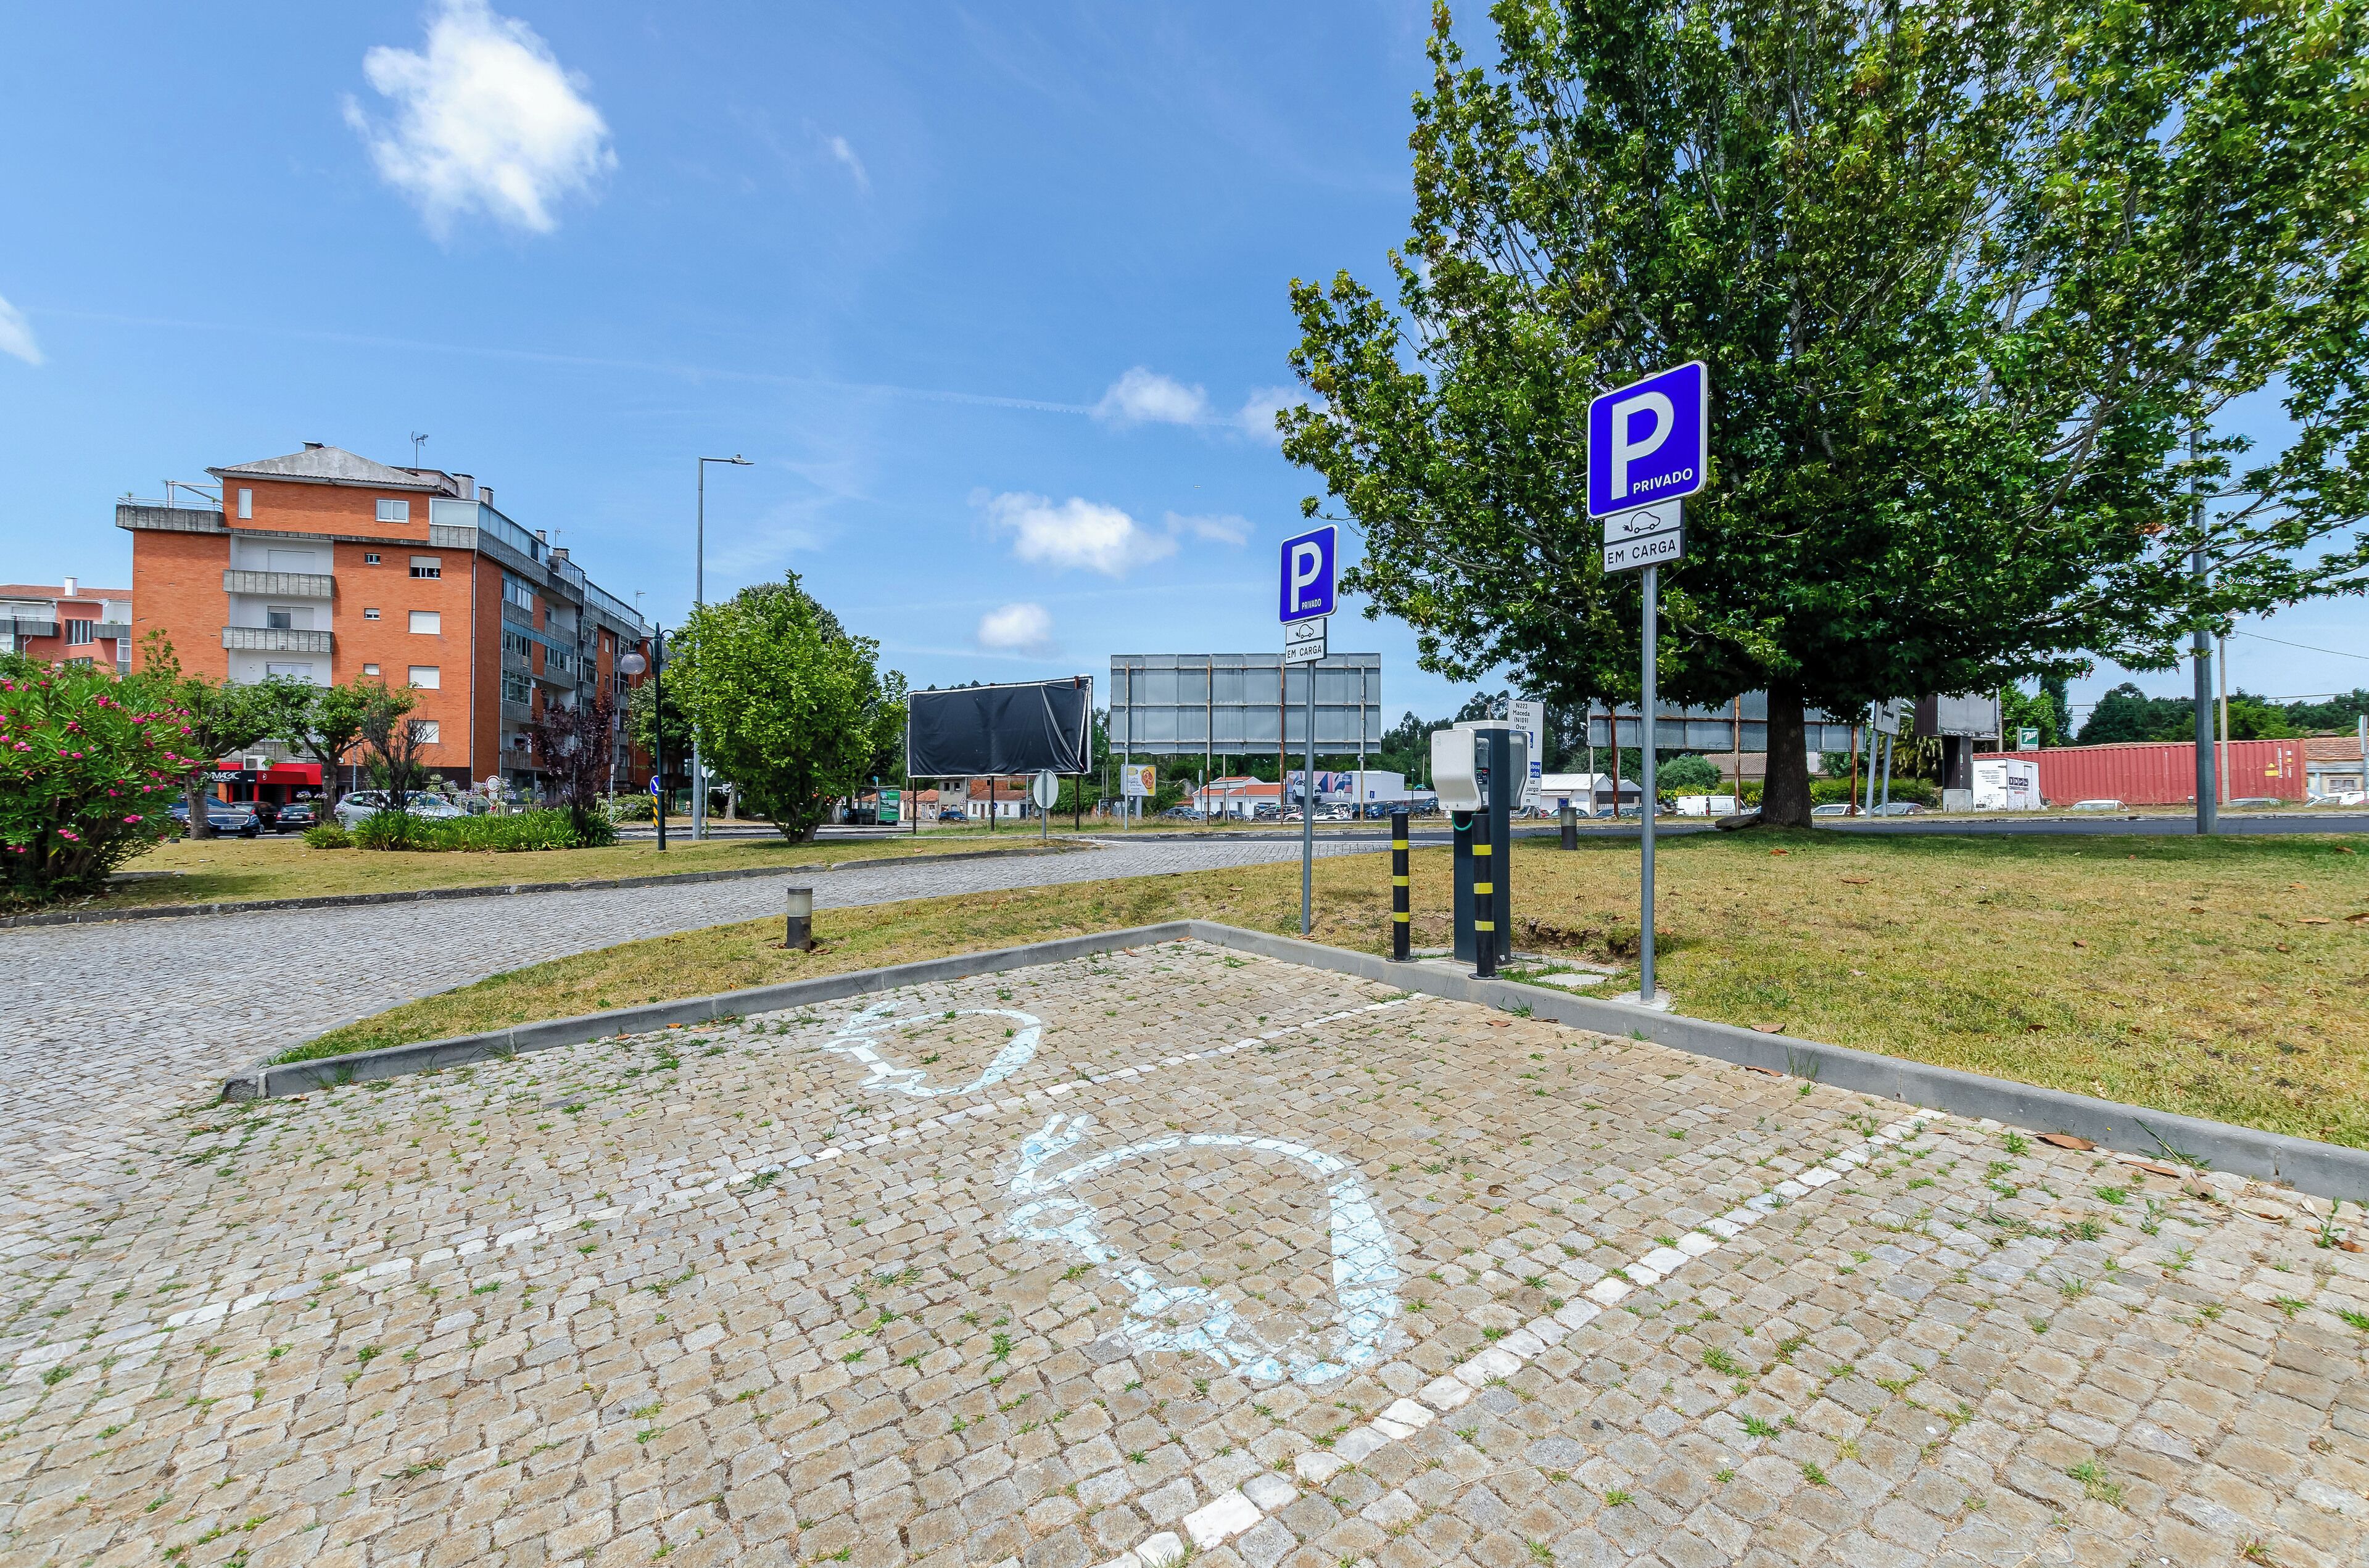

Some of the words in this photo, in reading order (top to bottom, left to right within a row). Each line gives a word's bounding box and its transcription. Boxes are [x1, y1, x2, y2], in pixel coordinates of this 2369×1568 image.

[1611, 391, 1674, 500] P
[1632, 468, 1693, 494] PRIVADO
[1608, 550, 1624, 564] EM
[1632, 538, 1676, 559] CARGA
[1290, 542, 1322, 613] P
[1302, 598, 1321, 610] PRIVADO
[1288, 649, 1296, 658] EM
[1299, 645, 1322, 656] CARGA
